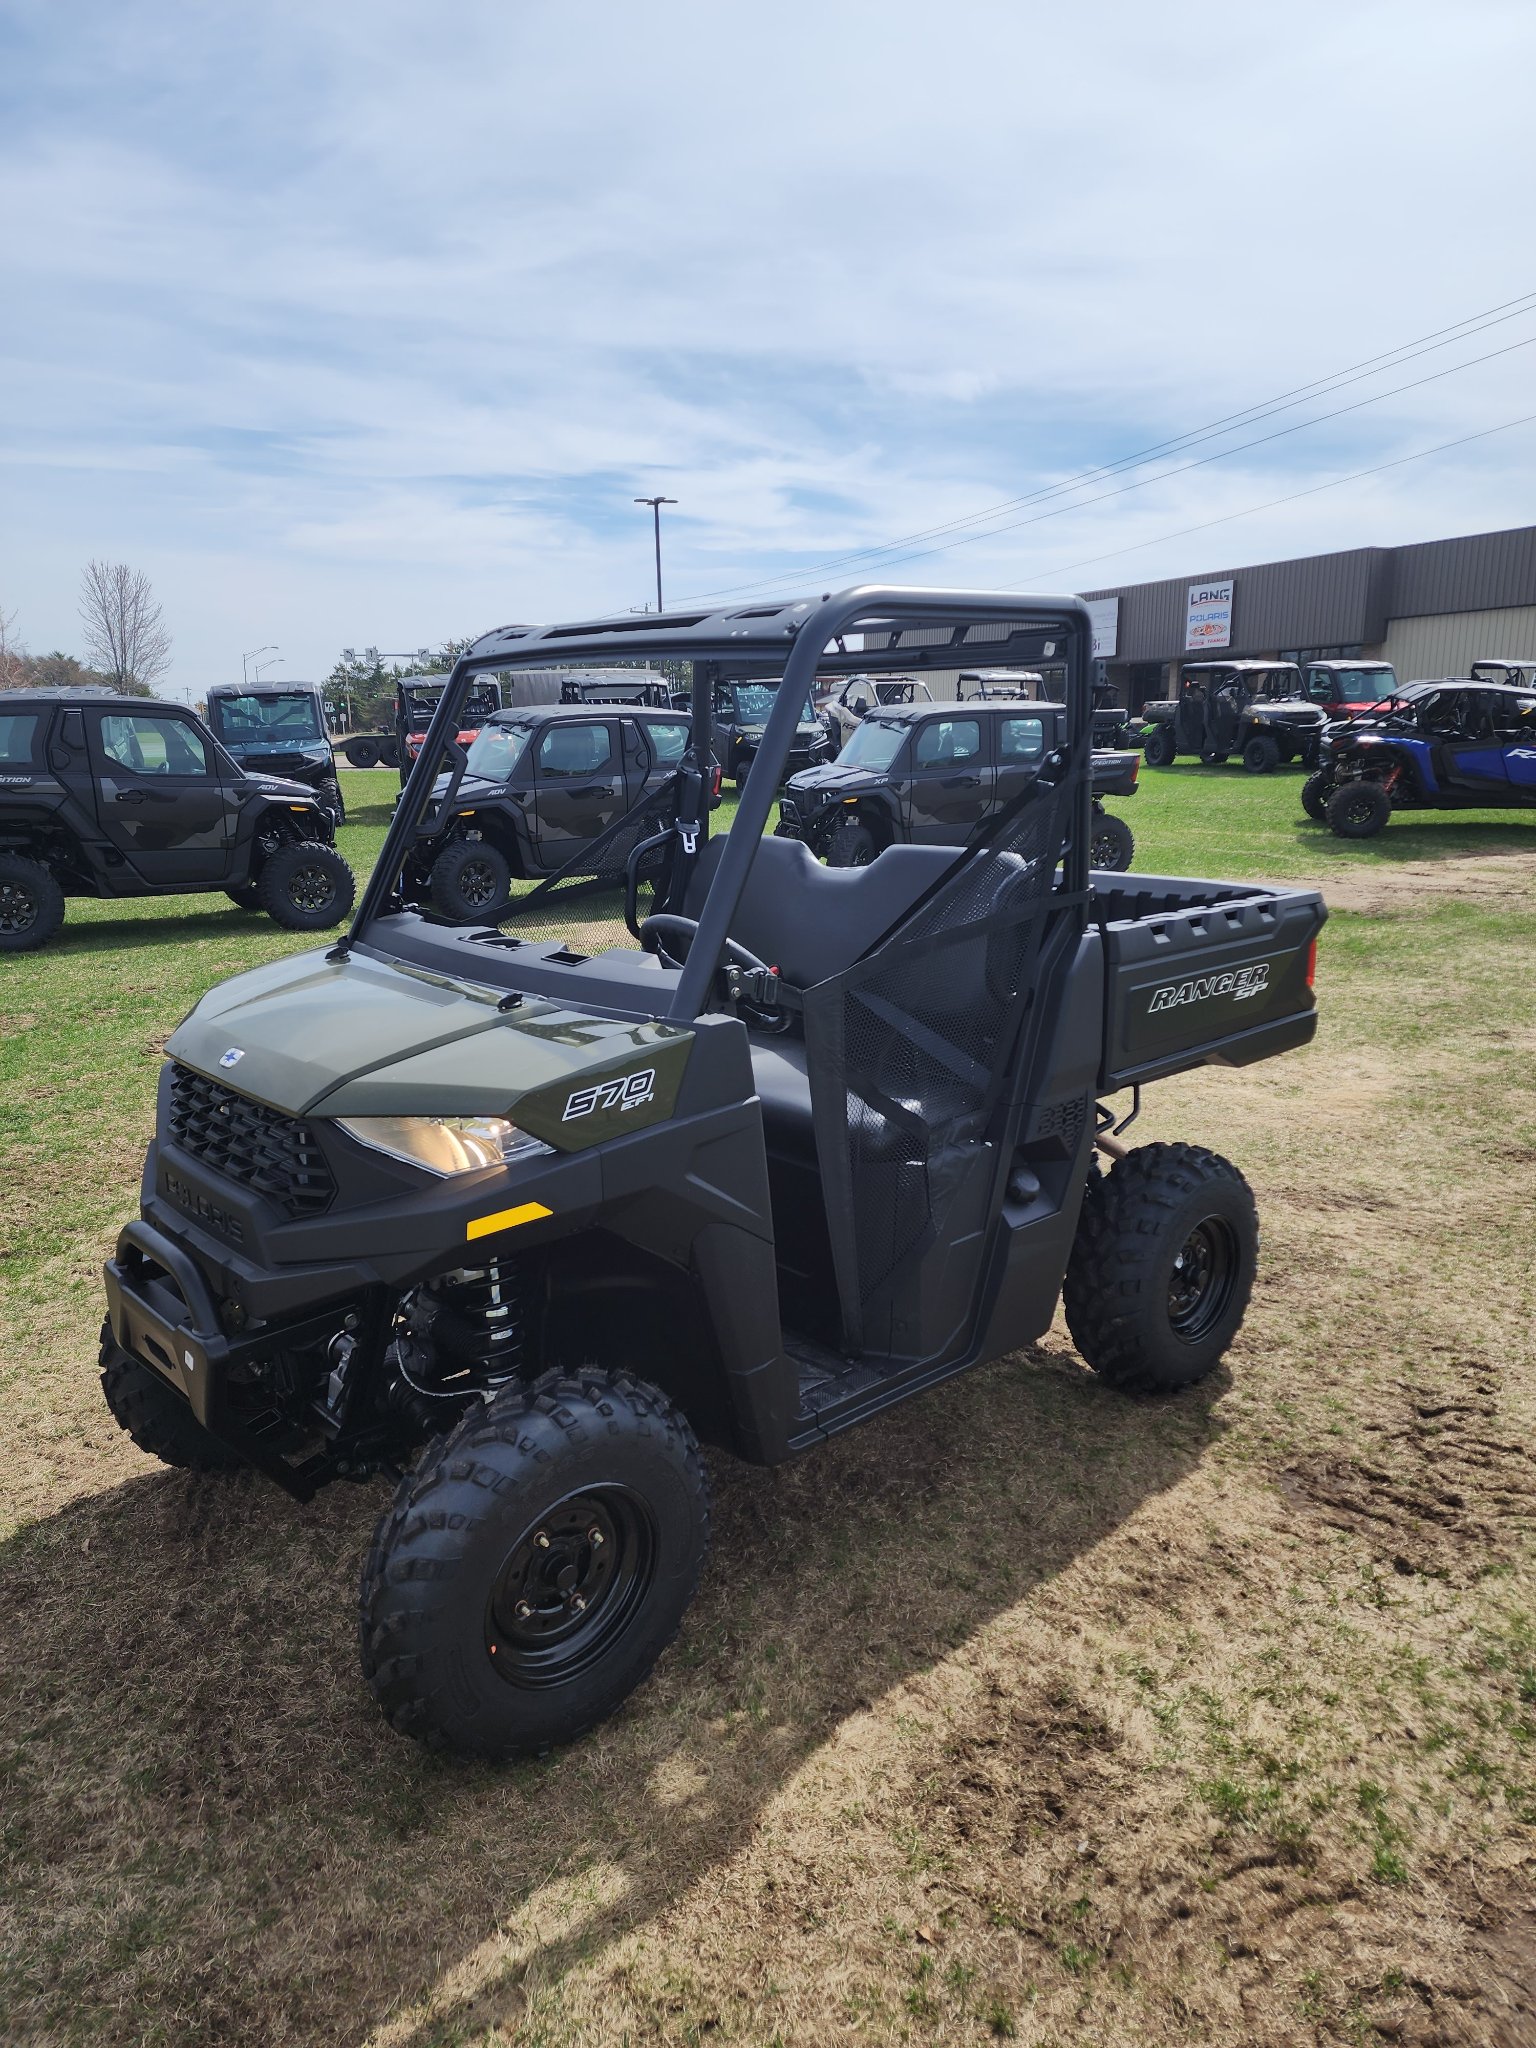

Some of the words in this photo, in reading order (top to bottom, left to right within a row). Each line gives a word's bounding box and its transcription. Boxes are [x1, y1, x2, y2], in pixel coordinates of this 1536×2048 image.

[1191, 589, 1231, 606] LANG
[1190, 611, 1229, 622] POLARIS
[874, 777, 889, 785] XP
[487, 787, 507, 796] ADV
[1147, 963, 1270, 1013] RANGER
[1231, 982, 1269, 1001] SP
[561, 1068, 656, 1122] 570
[620, 1092, 655, 1112] EFI
[165, 1171, 244, 1244] POLARIS
